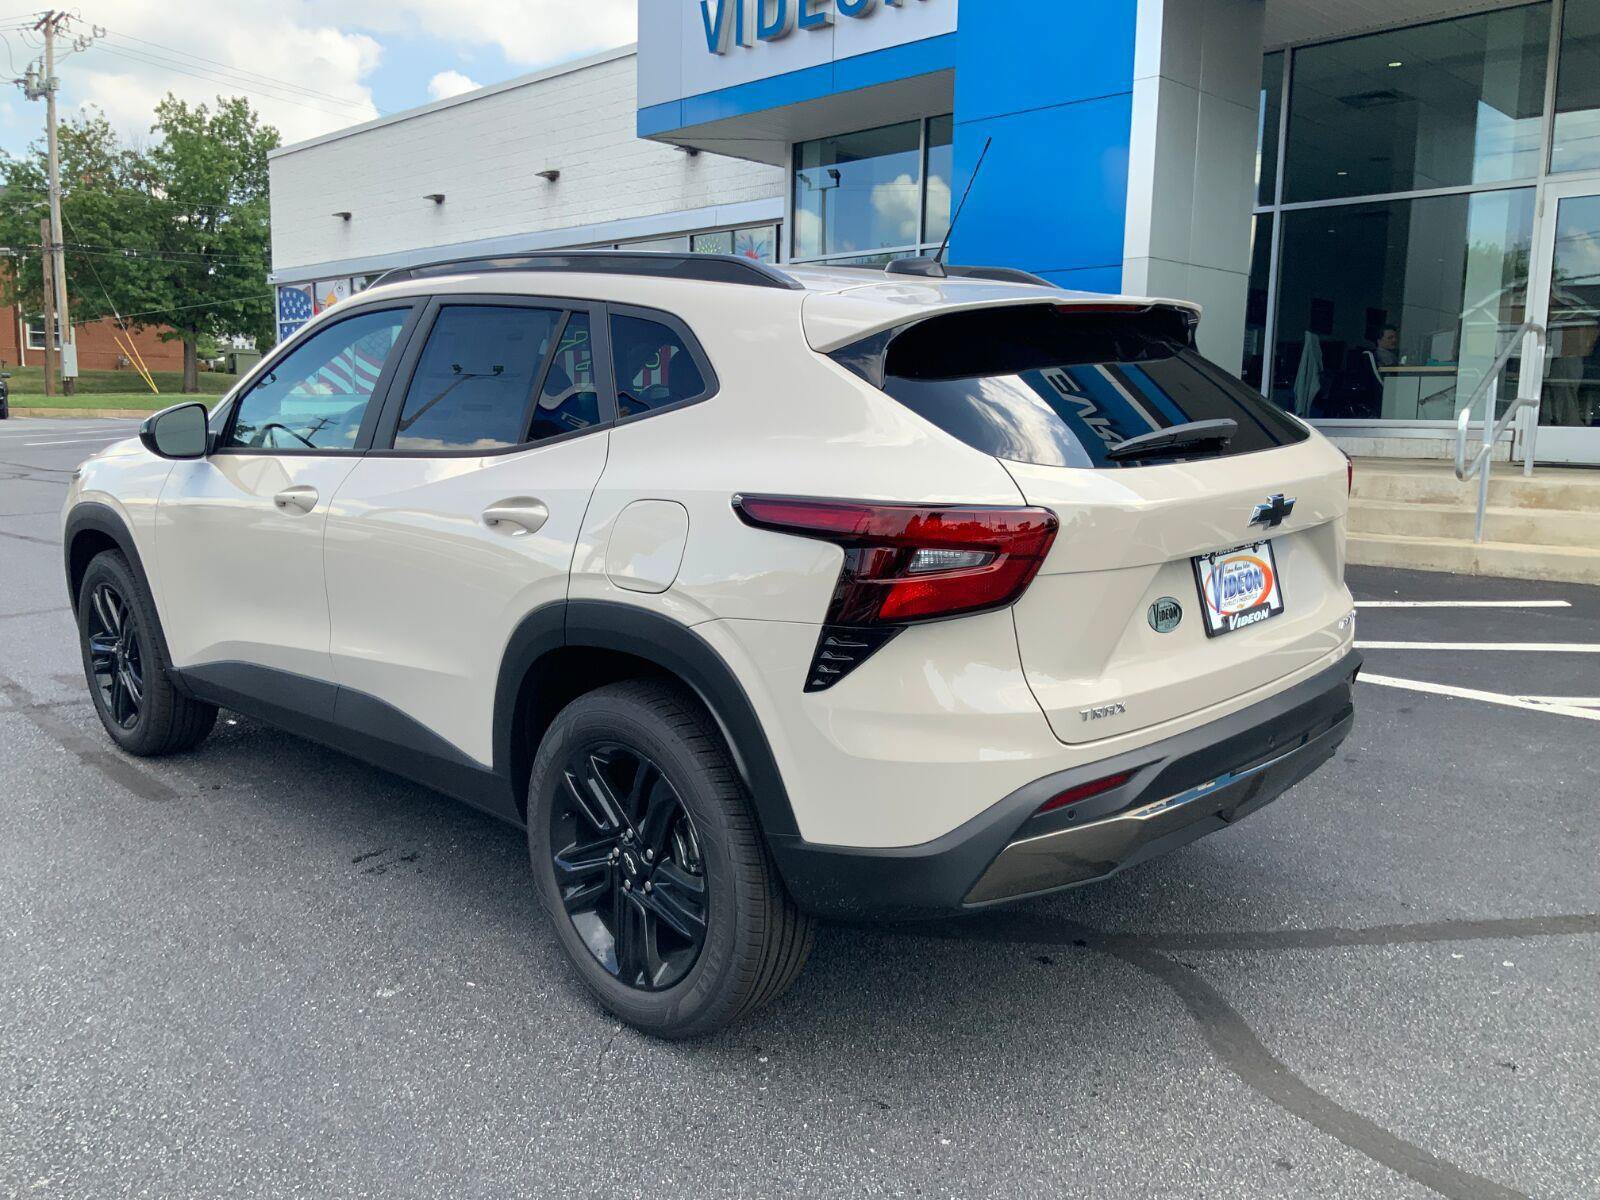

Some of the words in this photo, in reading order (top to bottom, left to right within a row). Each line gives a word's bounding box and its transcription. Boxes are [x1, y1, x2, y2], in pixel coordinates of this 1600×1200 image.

[700, 0, 926, 55] VIDE
[1211, 561, 1264, 615] VIDEON
[1229, 607, 1270, 630] VIDEON
[1079, 702, 1126, 721] TRAX
